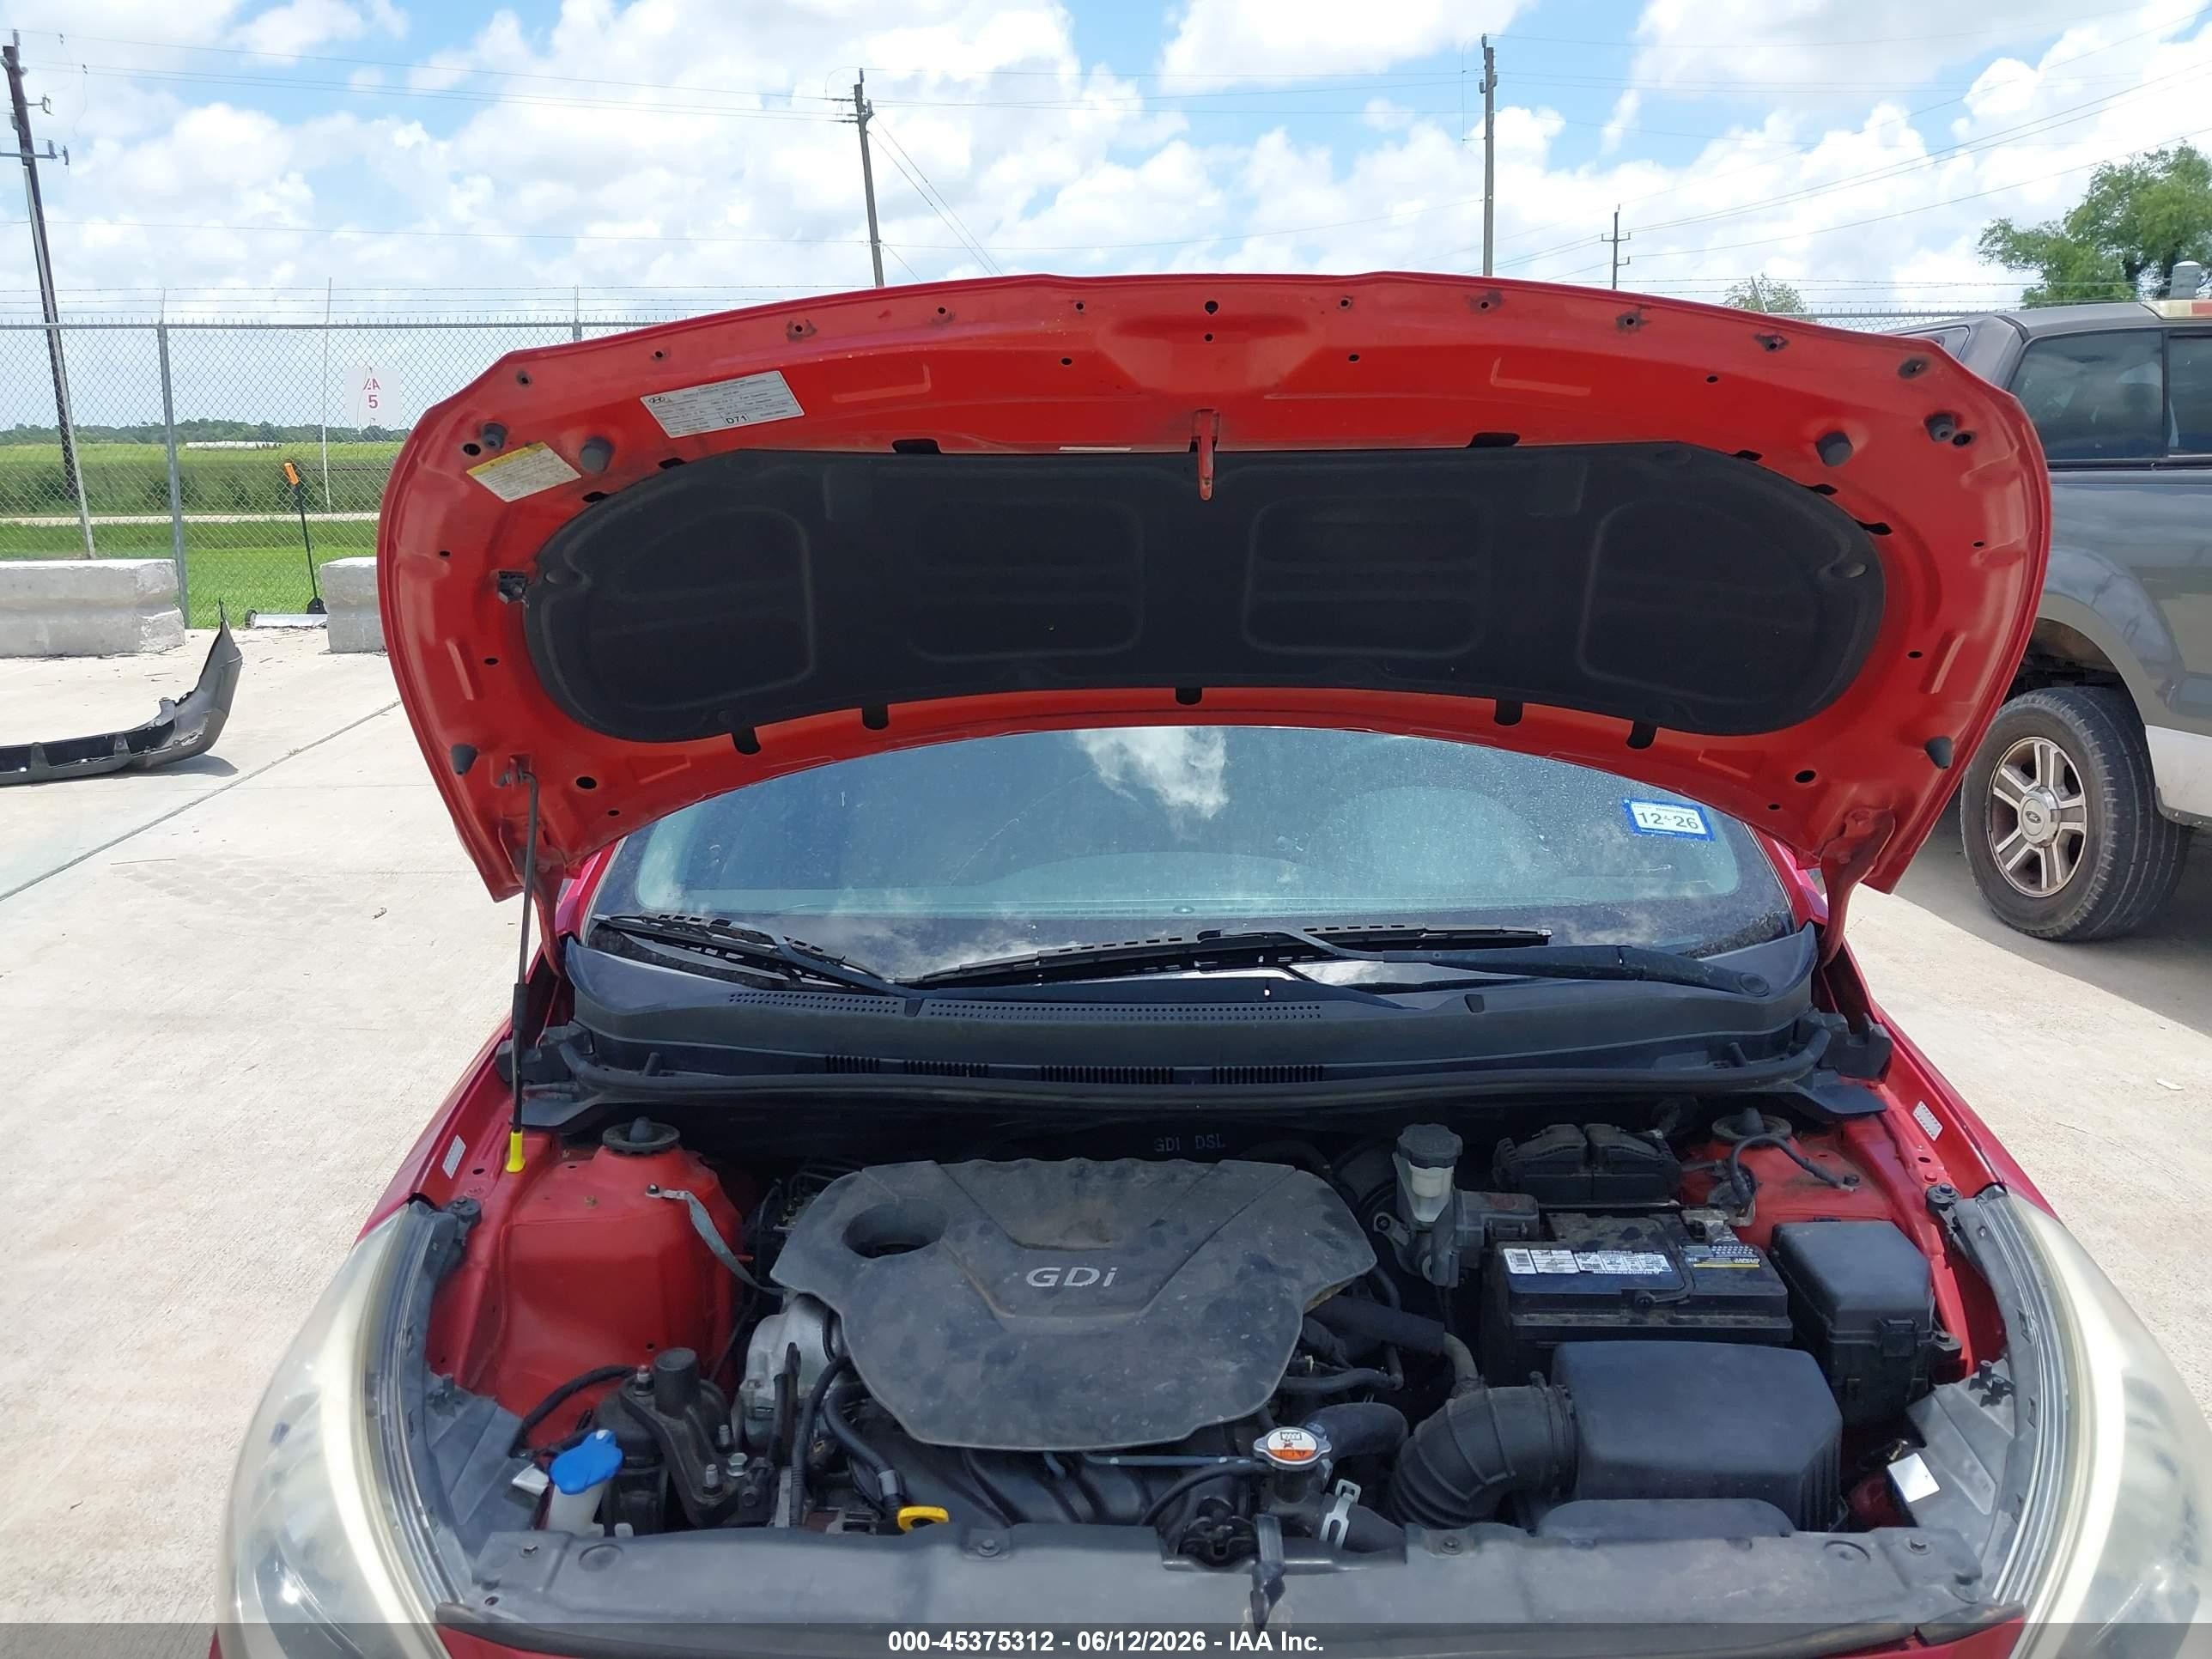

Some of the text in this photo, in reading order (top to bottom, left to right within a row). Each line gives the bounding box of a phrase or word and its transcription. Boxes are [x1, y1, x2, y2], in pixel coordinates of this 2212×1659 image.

[368, 394, 379, 409] 5
[725, 415, 749, 425] D71
[1025, 1267, 1118, 1287] GDi
